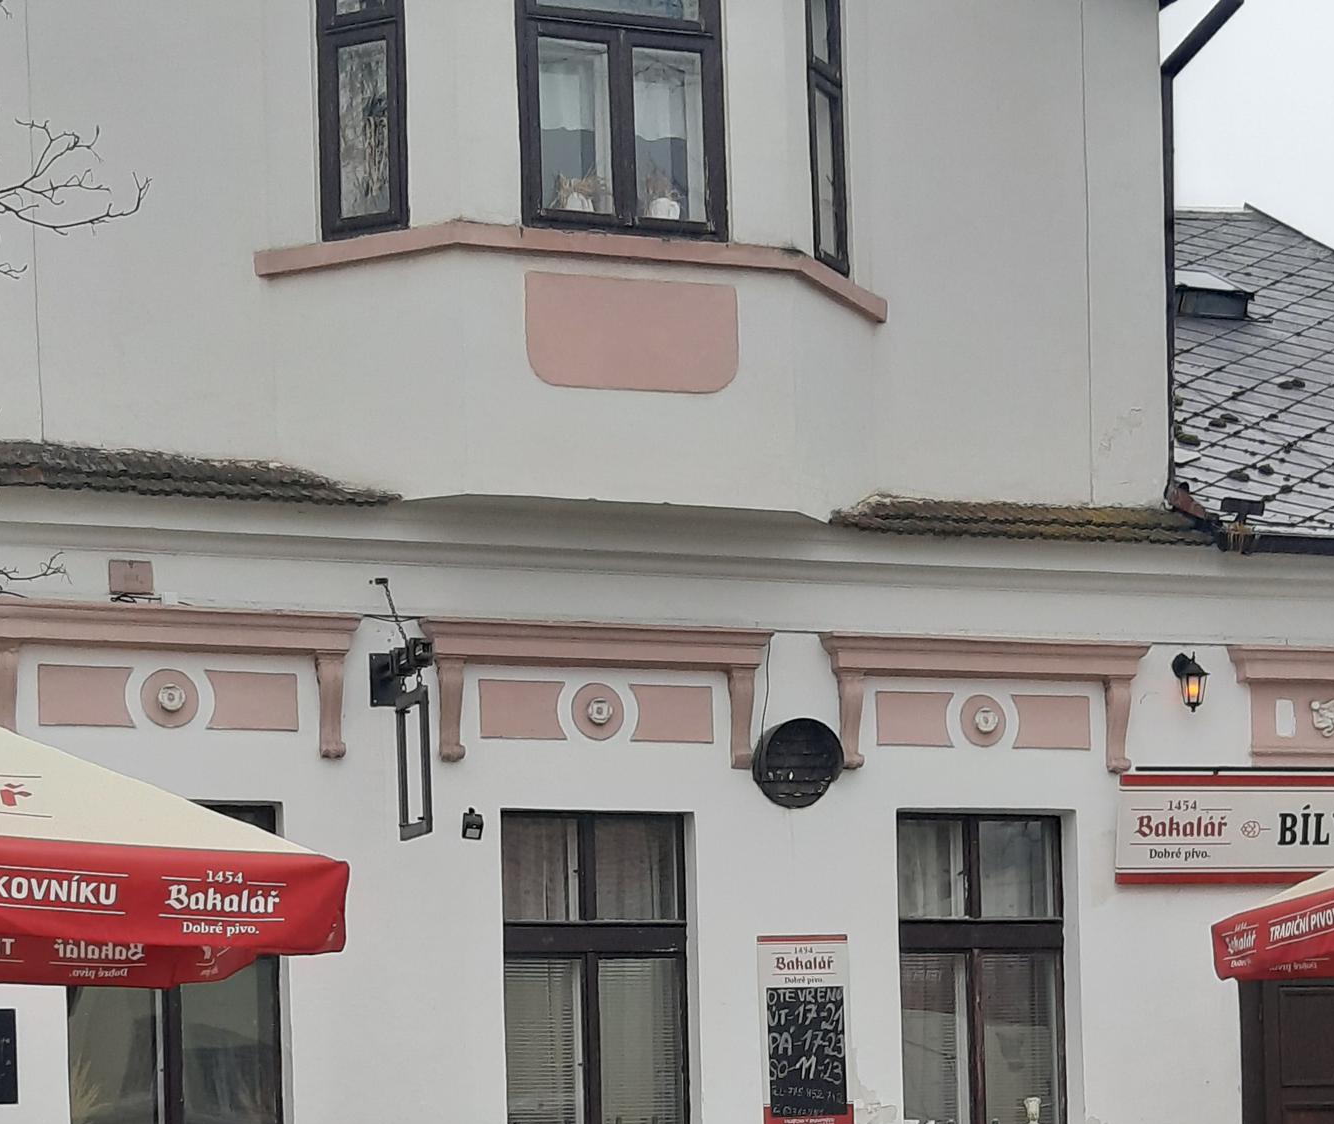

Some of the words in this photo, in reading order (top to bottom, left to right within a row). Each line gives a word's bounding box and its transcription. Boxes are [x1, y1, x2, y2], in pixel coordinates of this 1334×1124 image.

[1167, 799, 1198, 813] 1454
[1134, 814, 1228, 838] Bakalář
[1149, 848, 1181, 860] Dobré
[1184, 848, 1212, 861] pivo.
[206, 869, 244, 884] 1454
[164, 883, 280, 914] Bakalář
[182, 921, 223, 935] Dobré
[226, 923, 260, 938] pivo.
[1269, 912, 1310, 942] TRADIČNÍ
[773, 956, 834, 970] Bakalář
